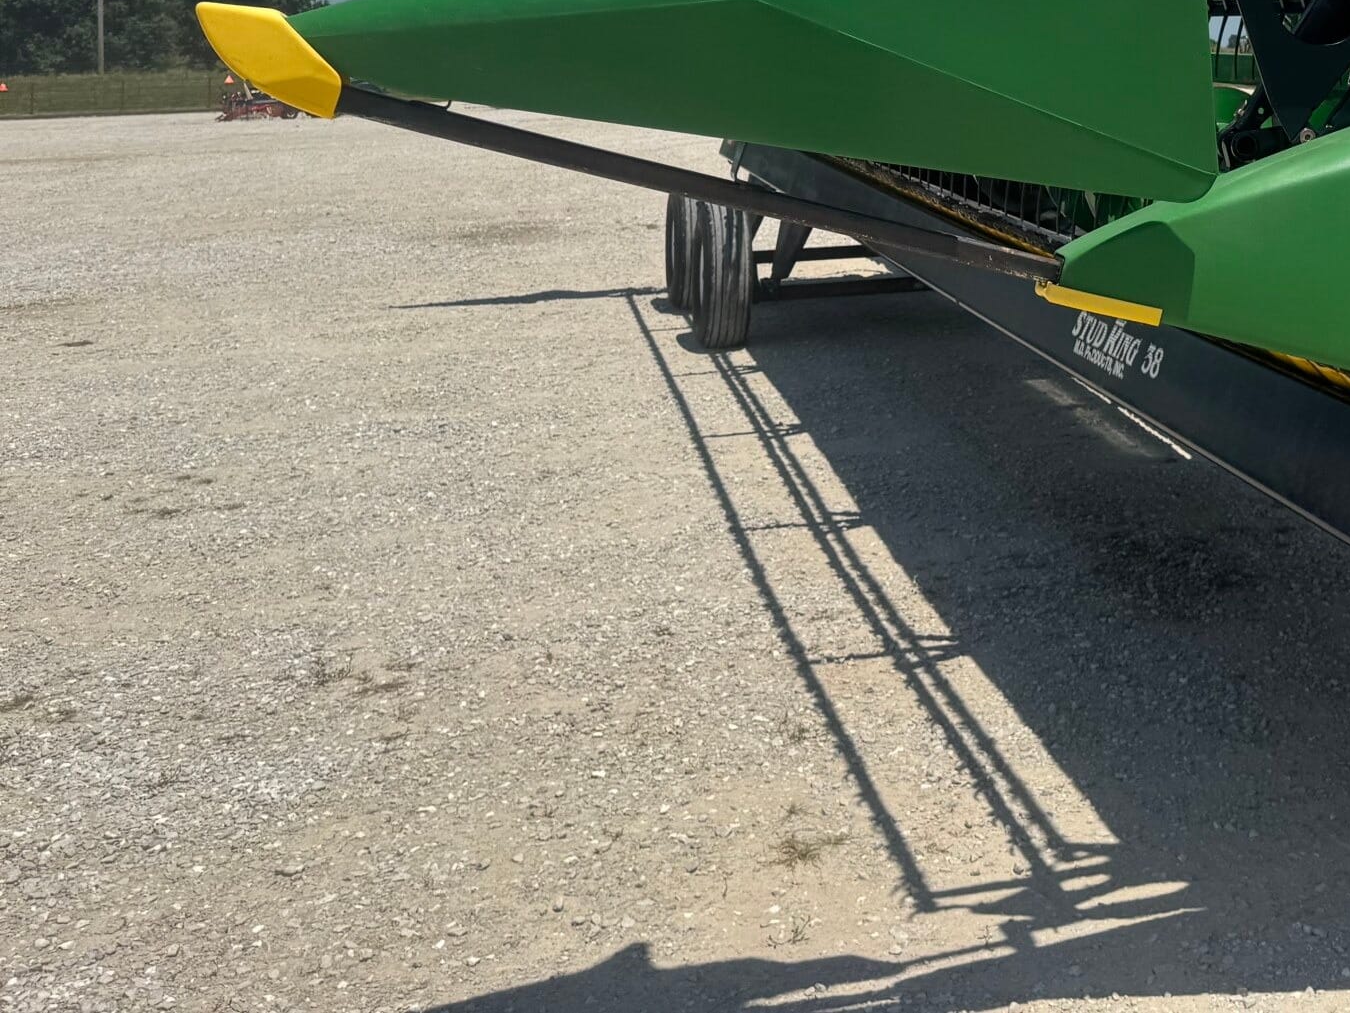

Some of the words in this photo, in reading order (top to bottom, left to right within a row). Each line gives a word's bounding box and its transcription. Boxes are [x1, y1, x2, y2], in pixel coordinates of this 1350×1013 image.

[1072, 311, 1108, 348] STUD
[1103, 320, 1143, 366] KING
[1141, 343, 1164, 379] 38
